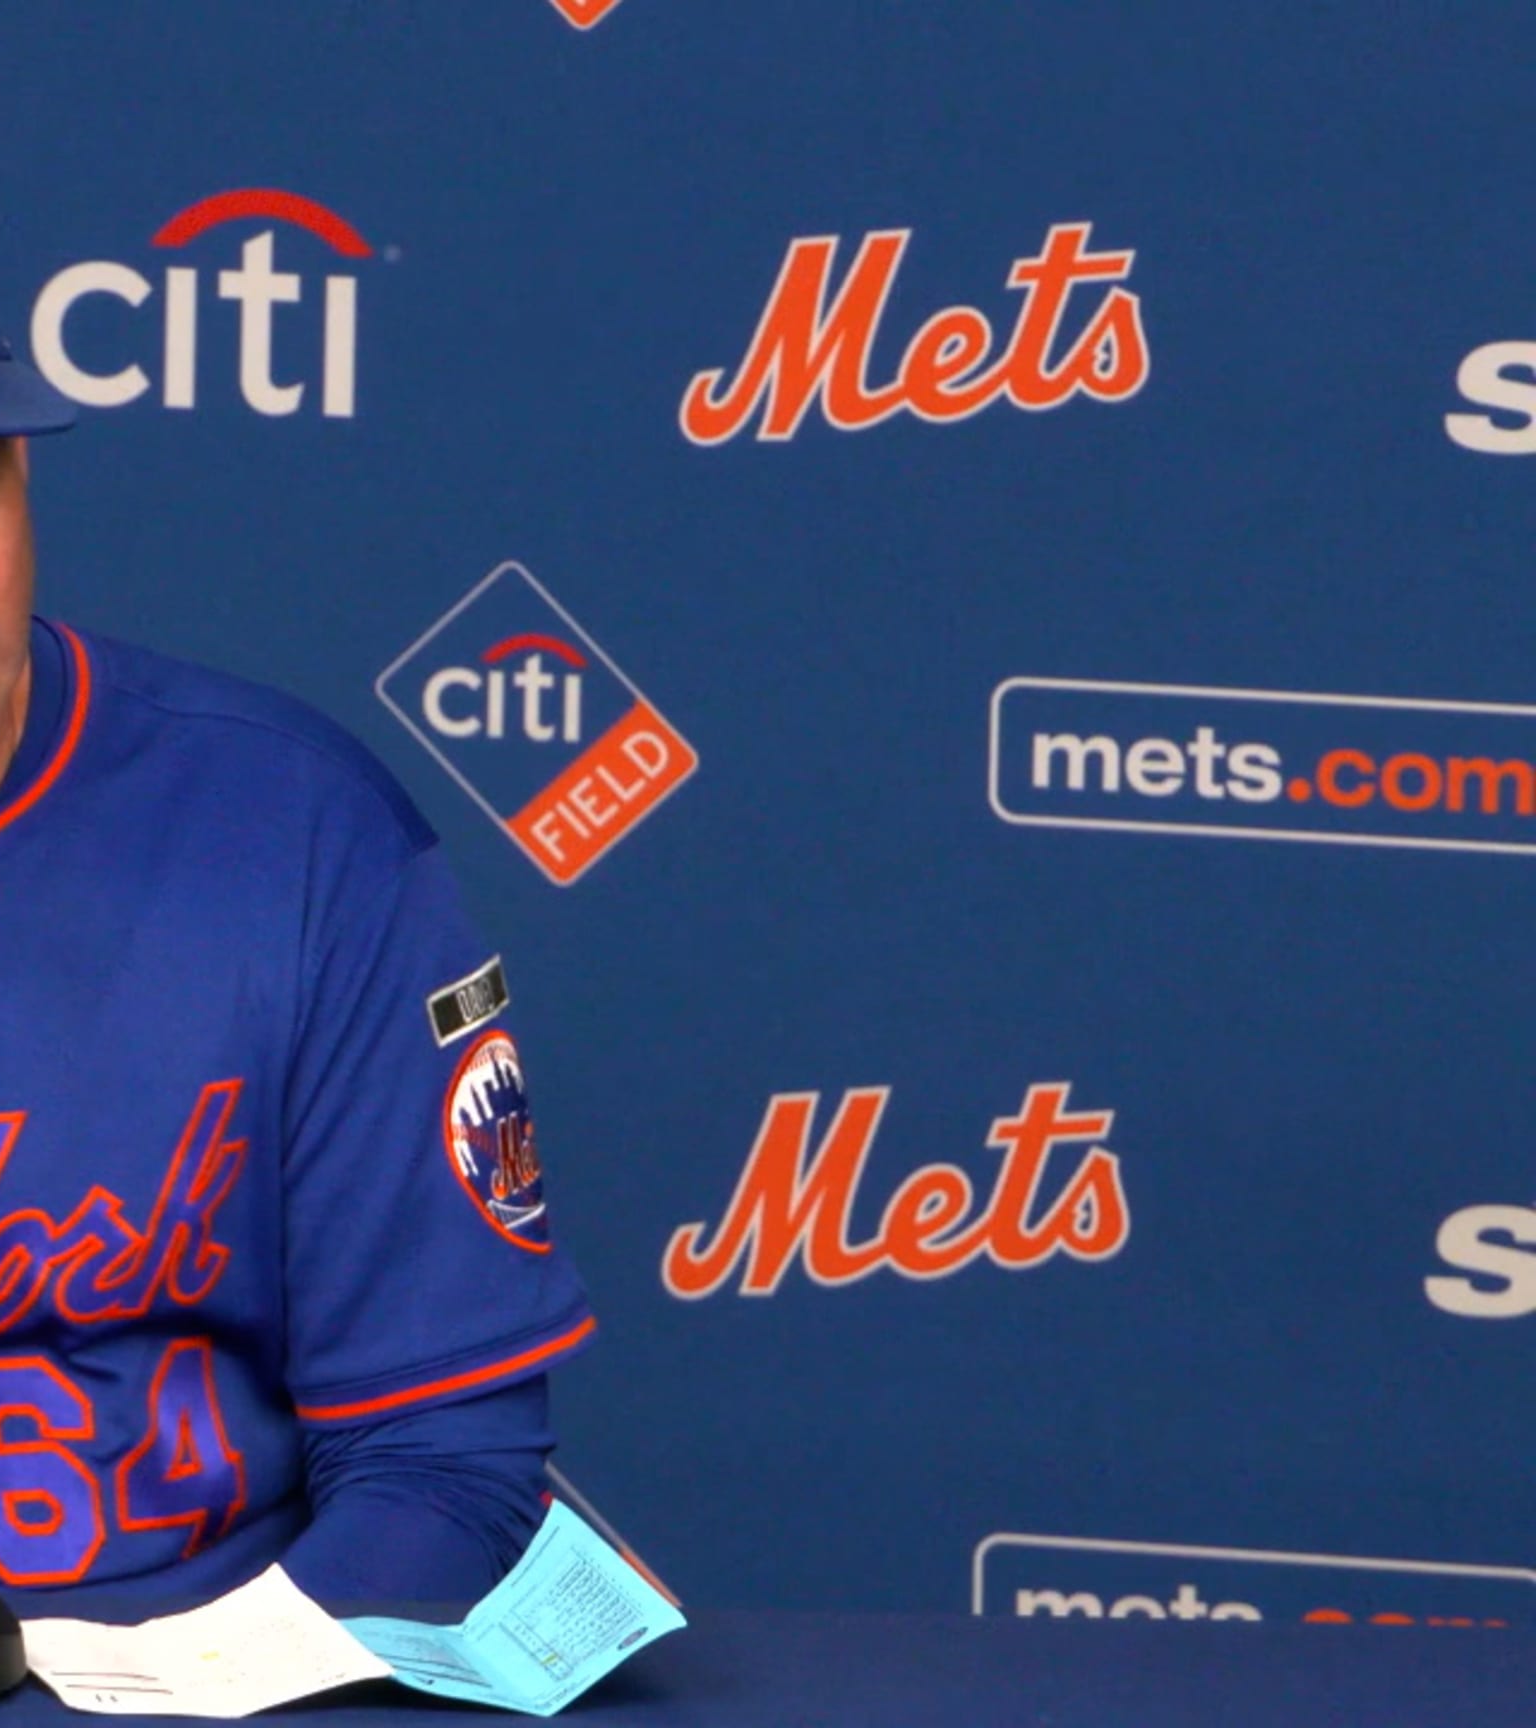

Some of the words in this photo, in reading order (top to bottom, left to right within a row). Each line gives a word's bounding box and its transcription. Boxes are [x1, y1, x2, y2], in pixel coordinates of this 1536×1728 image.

[31, 231, 357, 418] citi
[679, 221, 1151, 447] Mets
[422, 654, 582, 743] citi
[1032, 727, 1536, 816] mets.com
[531, 729, 670, 862] FIELD
[662, 1081, 1130, 1300] Mets
